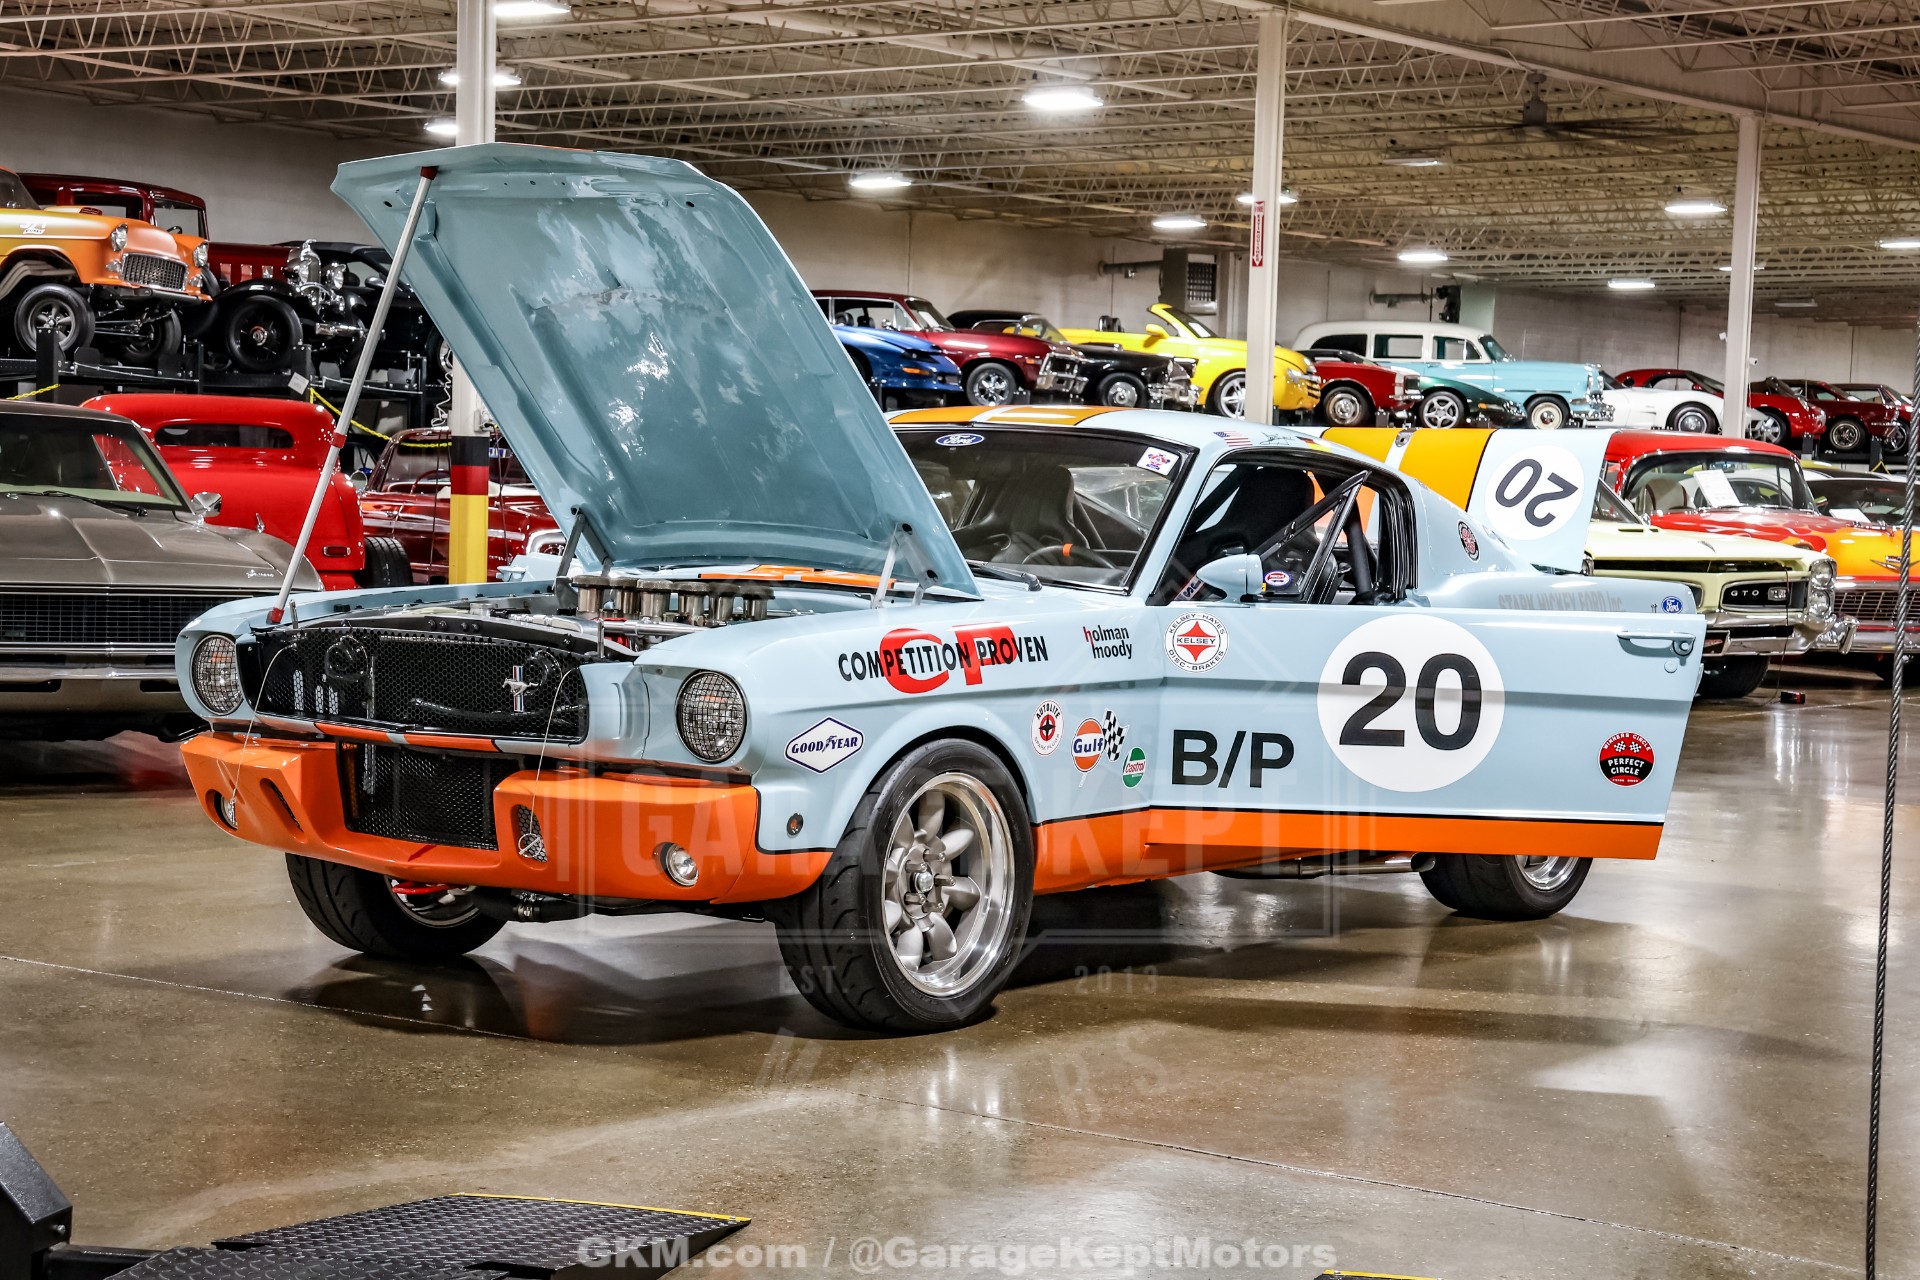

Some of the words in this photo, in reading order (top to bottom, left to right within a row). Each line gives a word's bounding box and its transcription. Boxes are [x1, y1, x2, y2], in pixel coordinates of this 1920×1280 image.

[1495, 458, 1579, 527] 20
[1731, 589, 1760, 597] GTO
[1083, 624, 1130, 643] holman
[1177, 637, 1217, 645] KELSEY
[1091, 639, 1133, 660] moody
[838, 641, 973, 682] COMPETITION
[974, 635, 1049, 667] PROVEN
[1339, 651, 1482, 751] 20
[1036, 703, 1061, 720] AUTOLITE
[1073, 737, 1104, 754] Gulf
[1632, 734, 1652, 751] CIRCLE
[1125, 761, 1146, 773] Castrol
[1172, 729, 1295, 788] B/P
[1607, 757, 1645, 768] PERFECT
[1610, 767, 1640, 775] CIRCLE
